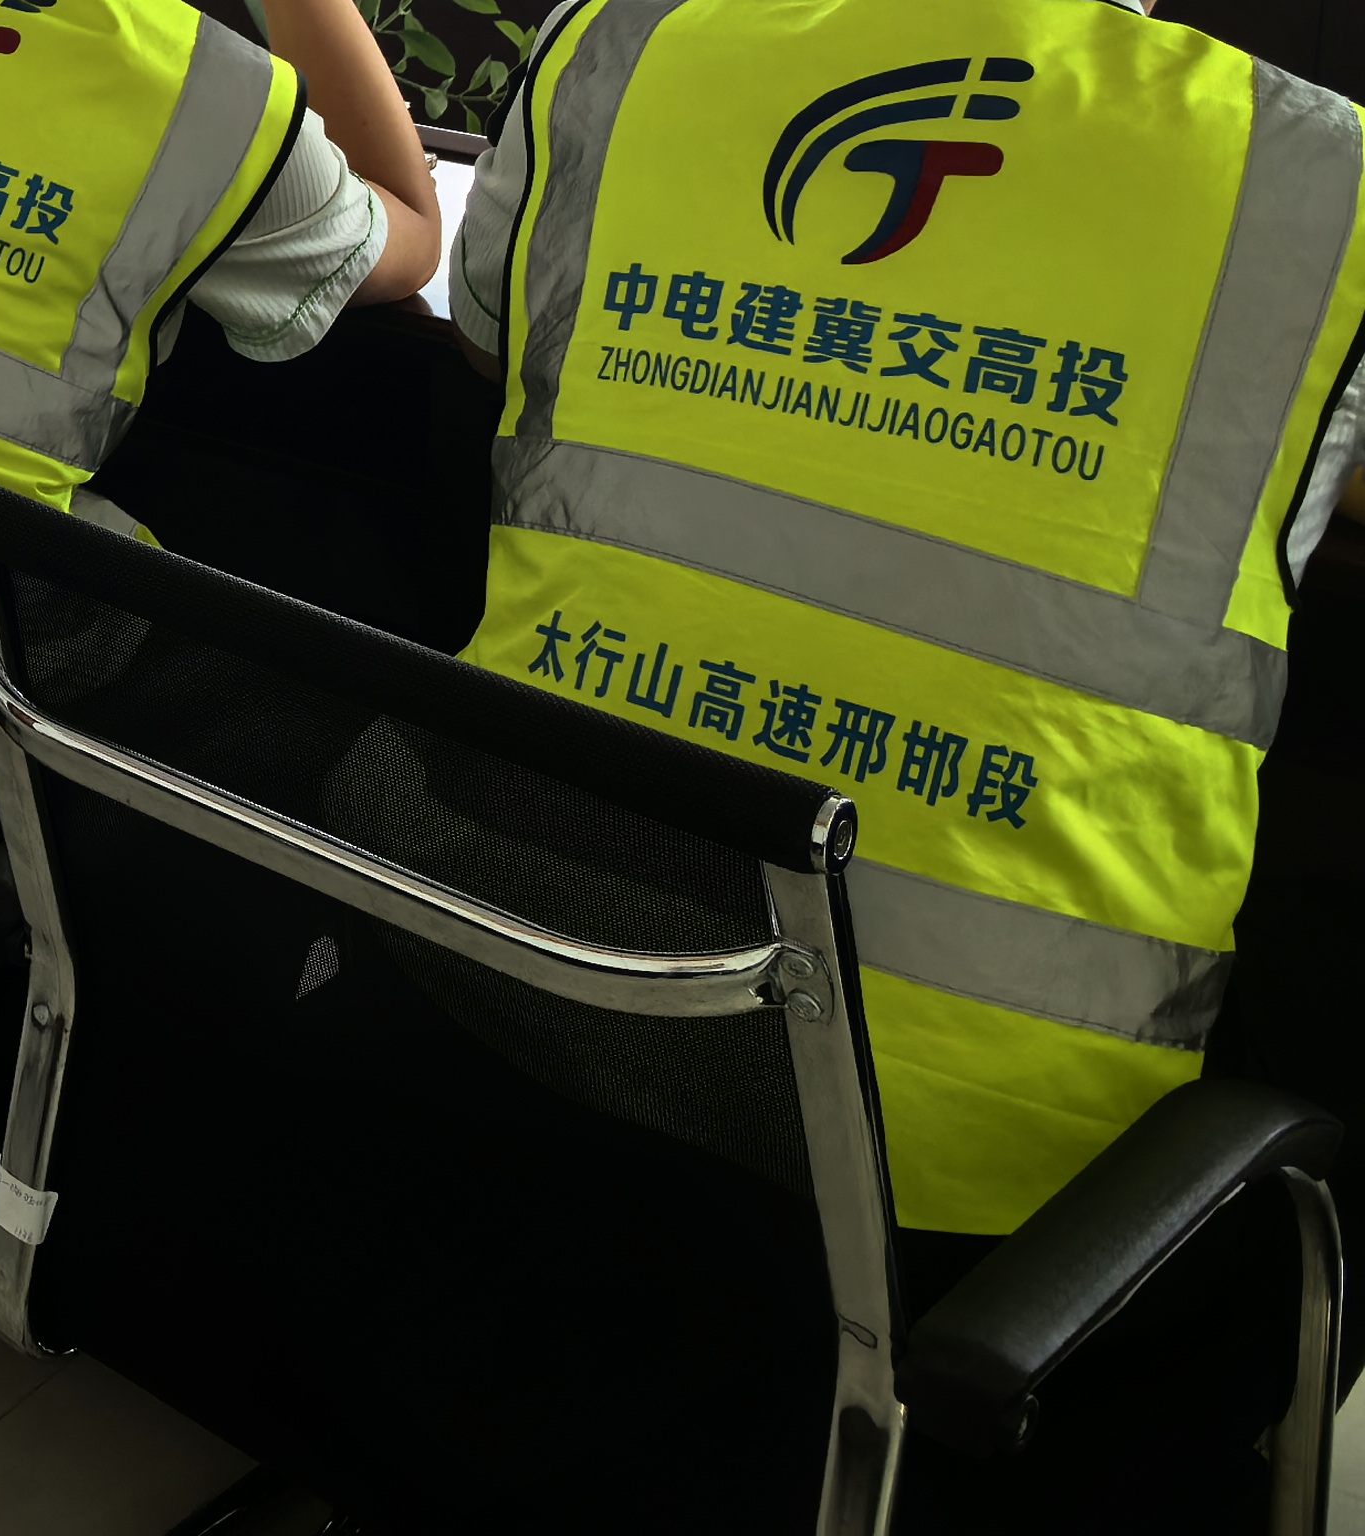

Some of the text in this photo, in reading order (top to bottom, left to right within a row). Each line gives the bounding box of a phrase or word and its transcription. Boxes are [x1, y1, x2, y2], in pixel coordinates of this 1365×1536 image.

[598, 346, 1105, 481] ZHONGDIANJIANJIJIAOGAOTOU
[603, 263, 1128, 426] 中电建冀交高投
[528, 610, 1038, 829] 太行山高速邢邯段
